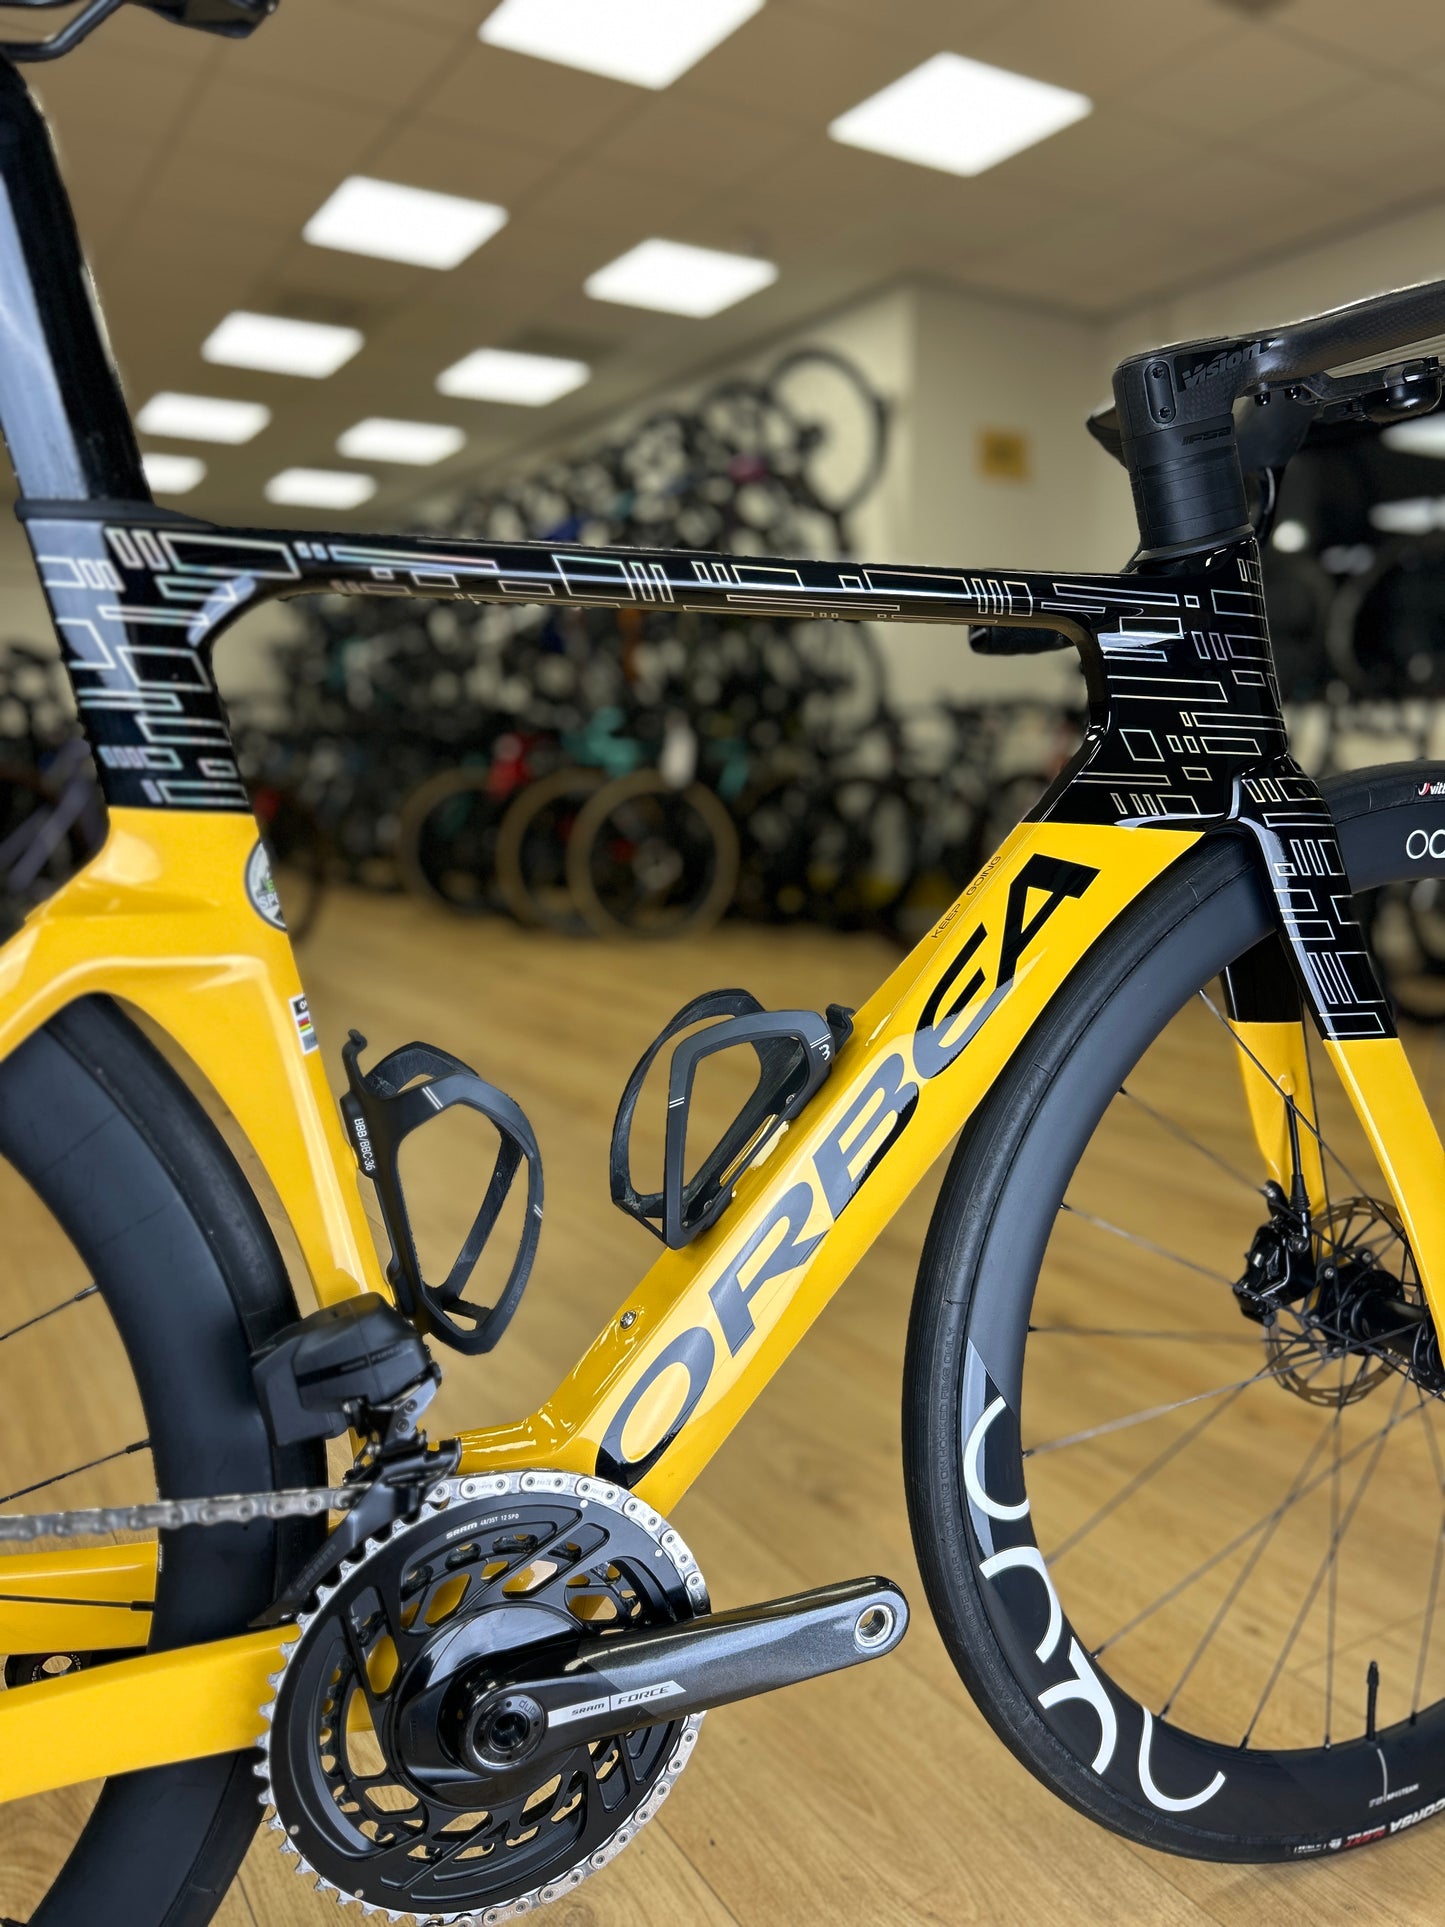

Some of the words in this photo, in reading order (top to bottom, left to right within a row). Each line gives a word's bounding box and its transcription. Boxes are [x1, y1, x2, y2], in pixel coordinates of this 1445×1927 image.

[931, 903, 961, 938] KEEP
[966, 856, 1002, 896] GOING
[594, 852, 1102, 1489] ORBEA
[944, 1326, 956, 1364] ONLY
[941, 1367, 951, 1400] RIMS
[939, 1404, 949, 1457] HOOKED
[446, 1522, 478, 1540] SRAM
[571, 1702, 605, 1716] SRAM
[617, 1685, 670, 1705] FORCE
